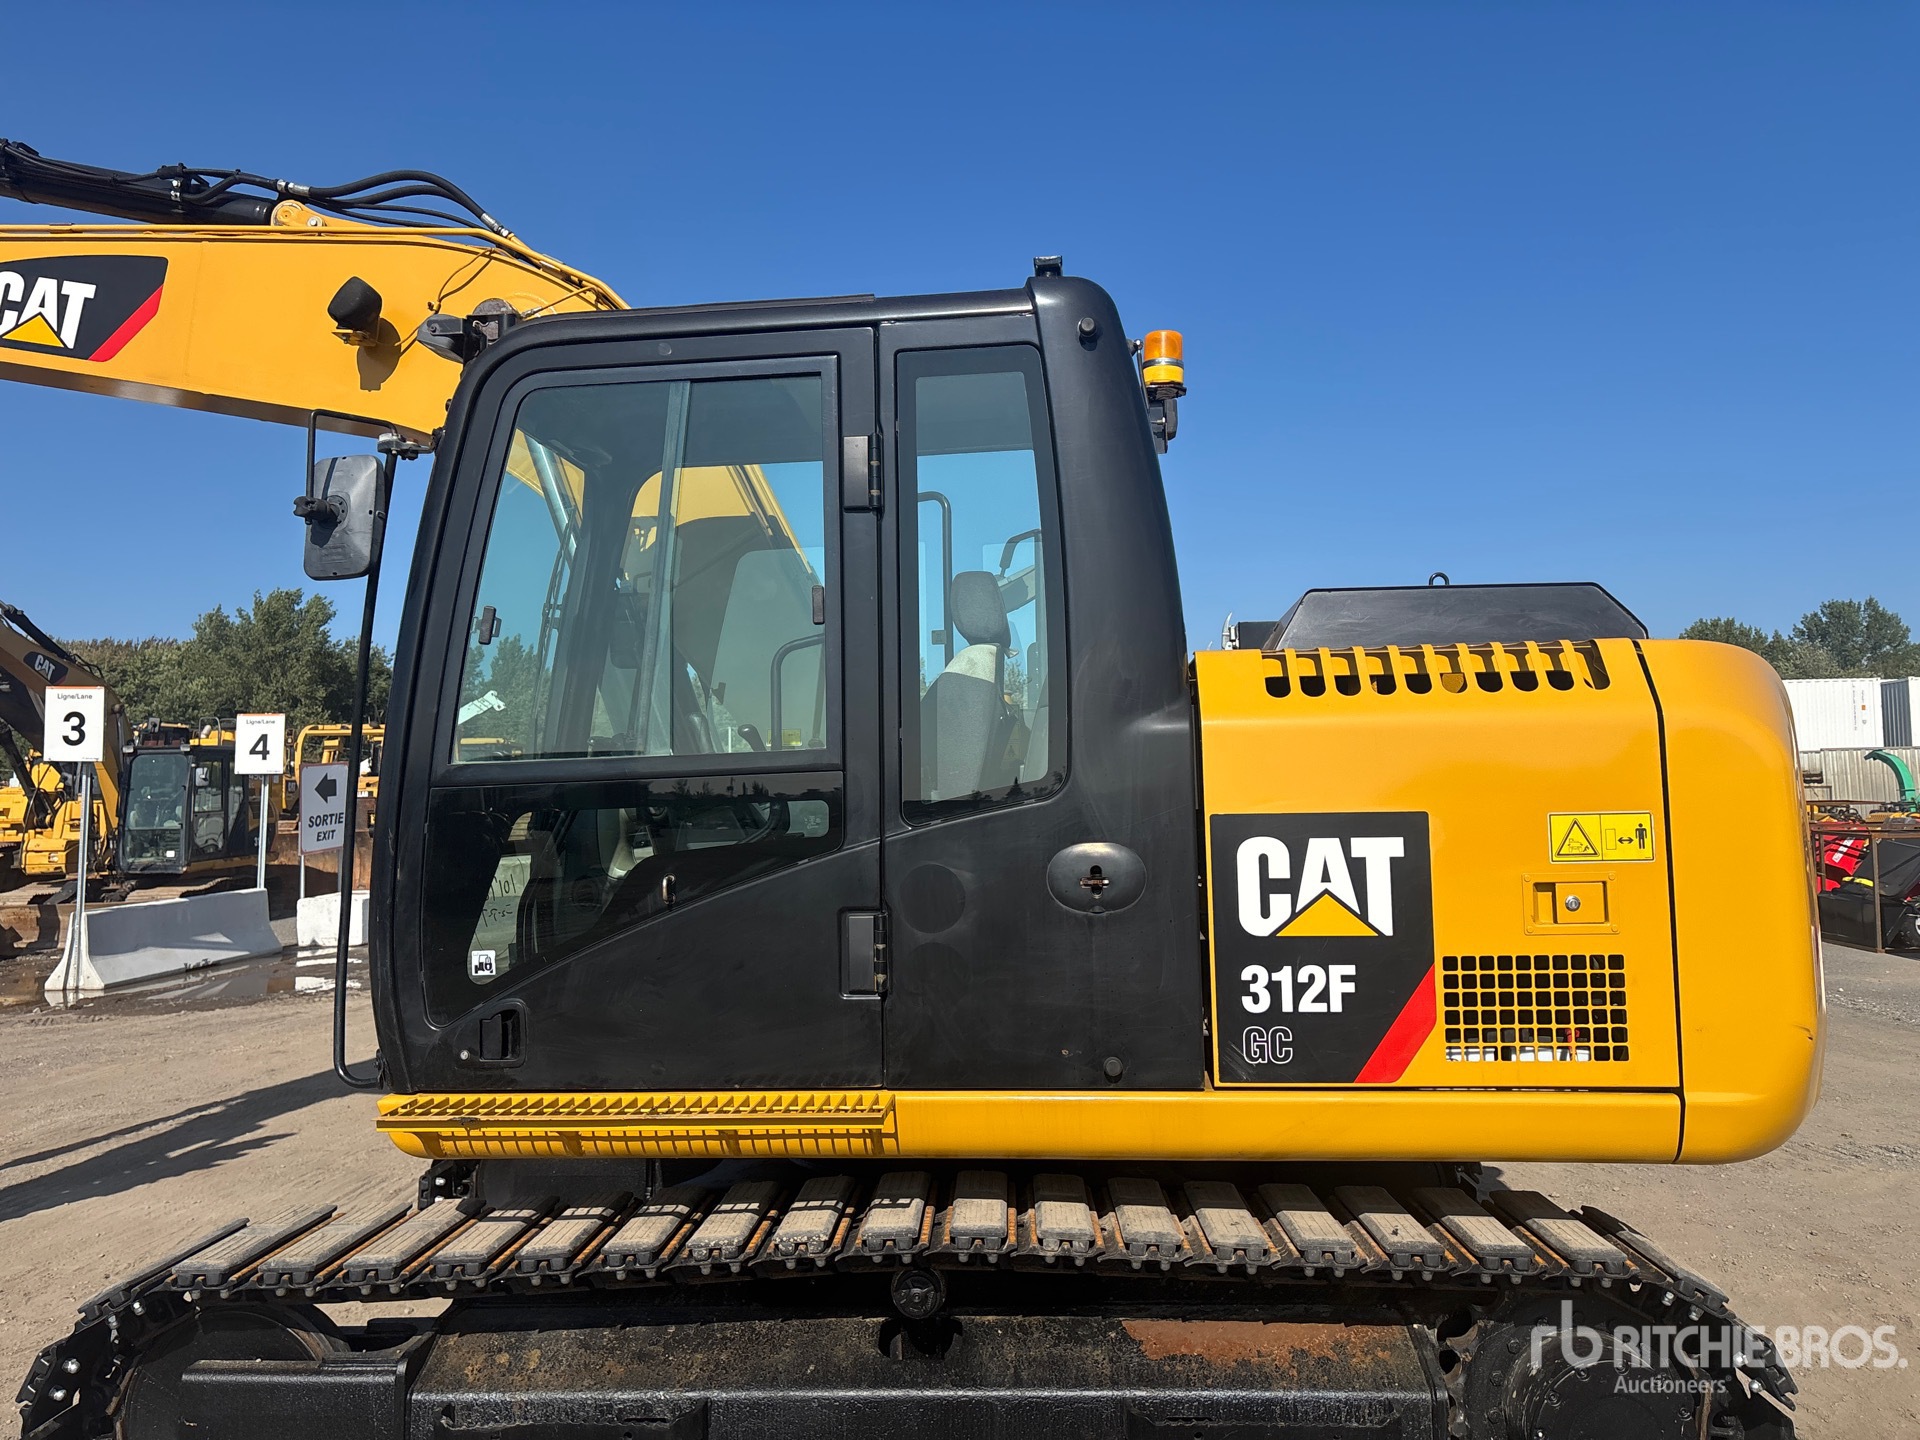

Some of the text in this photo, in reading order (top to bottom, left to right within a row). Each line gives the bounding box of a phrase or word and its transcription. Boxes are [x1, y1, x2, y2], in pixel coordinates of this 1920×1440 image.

[0, 271, 97, 350] CAT
[34, 655, 56, 681] CAT
[57, 693, 93, 701] Ligne/Lane
[62, 711, 86, 746] 3
[249, 734, 270, 760] 4
[308, 812, 344, 828] SORTIE
[316, 830, 336, 842] EXIT
[1236, 836, 1404, 937] CAT
[1240, 964, 1356, 1014] 312F
[1243, 1026, 1293, 1064] GC
